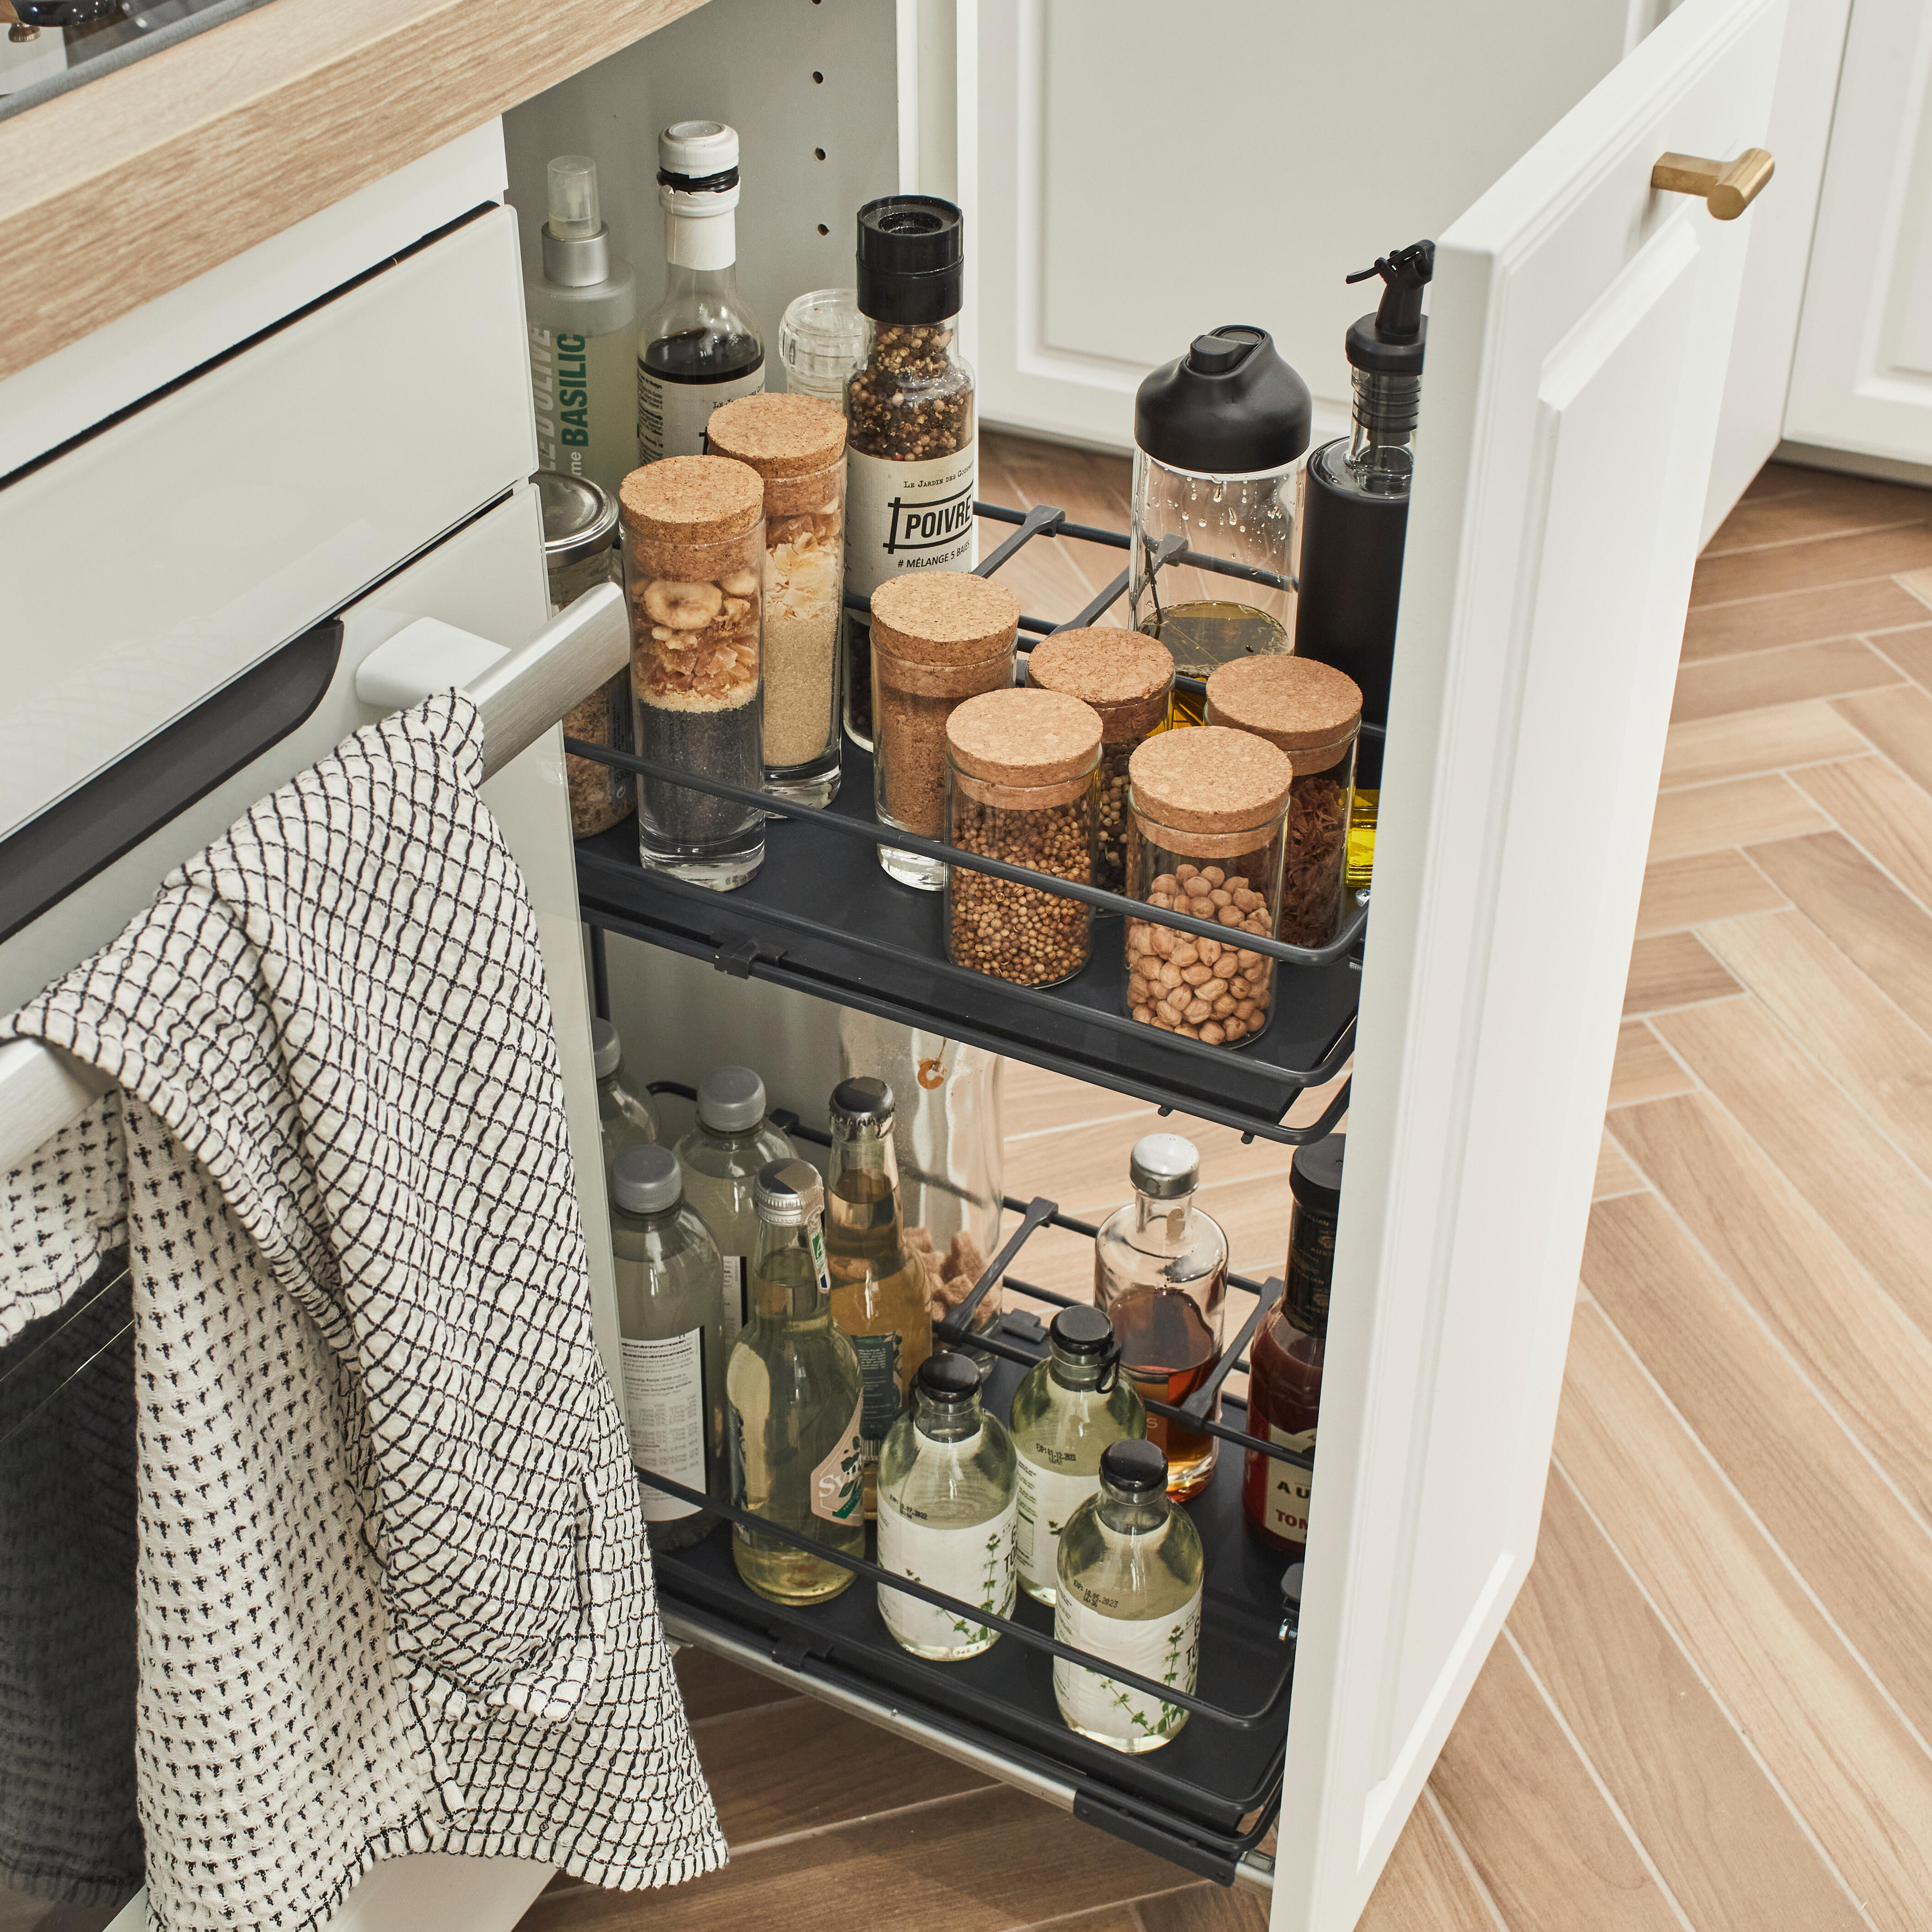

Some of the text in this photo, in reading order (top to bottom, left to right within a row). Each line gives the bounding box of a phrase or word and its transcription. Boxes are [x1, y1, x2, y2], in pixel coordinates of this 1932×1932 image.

[557, 333, 589, 446] BASILIC
[918, 479, 943, 488] JARDIN
[946, 474, 956, 482] DES
[905, 494, 971, 539] POIVRE
[897, 540, 970, 568] # MÉLANGE 5 BAIES
